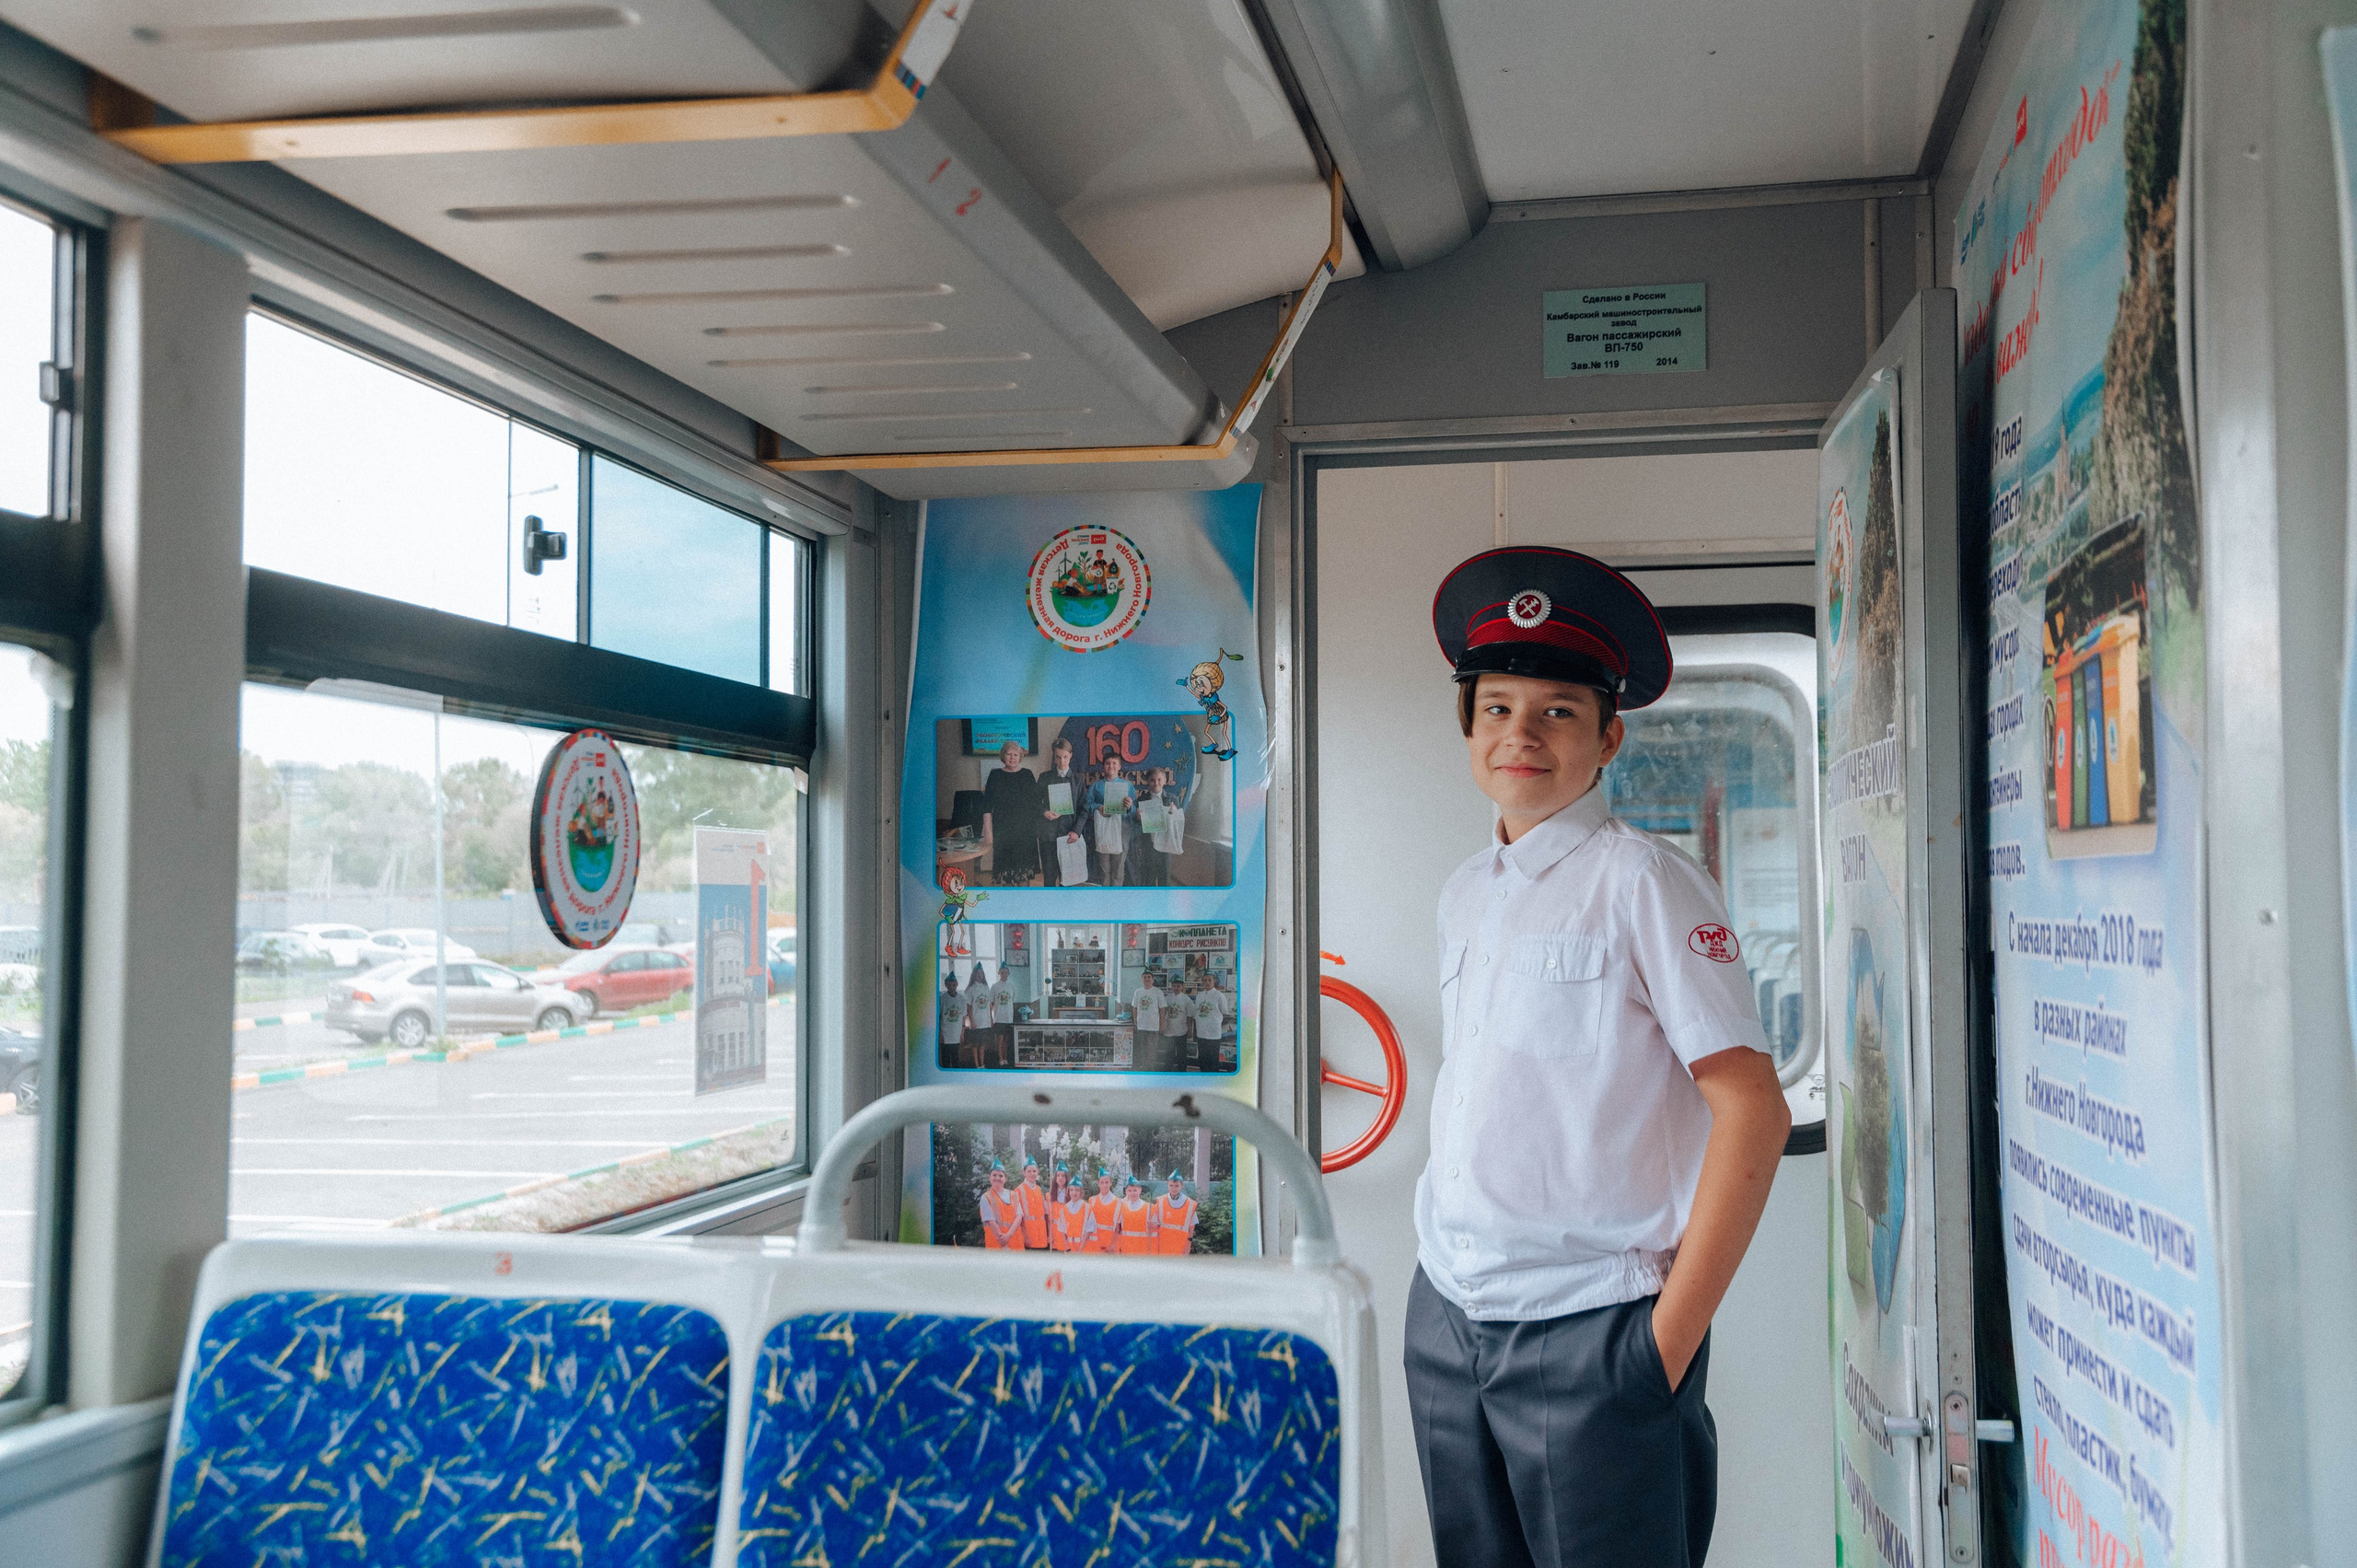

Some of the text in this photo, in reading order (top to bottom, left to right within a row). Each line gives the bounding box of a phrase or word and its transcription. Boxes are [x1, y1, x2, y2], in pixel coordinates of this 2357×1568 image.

[1547, 305, 1702, 321] Камбарский машиностроительный
[1583, 294, 1622, 304] Сделано
[1632, 292, 1666, 301] России
[1566, 328, 1682, 343] Вагон пассажирский
[1610, 319, 1638, 328] завод
[1571, 356, 1678, 371] Зав.№ 119 2014
[1604, 342, 1643, 353] ВП-750
[2000, 415, 2023, 459] года
[1038, 539, 1070, 576] Детская
[1115, 542, 1143, 598] Новгорода
[1035, 576, 1055, 629] железная
[1103, 599, 1140, 639] Нижнего
[1051, 626, 1091, 644] дорога
[1086, 720, 1150, 766] 160
[1168, 936, 1227, 948] КОНКУРС РИСУНКОВ
[2008, 911, 2164, 974] С начала декабря 2018 года
[2034, 999, 2128, 1057] в разных районах
[2026, 1065, 2146, 1158] г.Нижнего Новгорода
[2009, 1137, 2197, 1274] появились современные пункты
[2013, 1212, 2197, 1373] сдачи вторсырья, куда каждый
[2026, 1298, 2055, 1352] может
[2057, 1326, 2118, 1403] принести
[2120, 1371, 2133, 1413] и
[2033, 1424, 2085, 1562] Мусор
